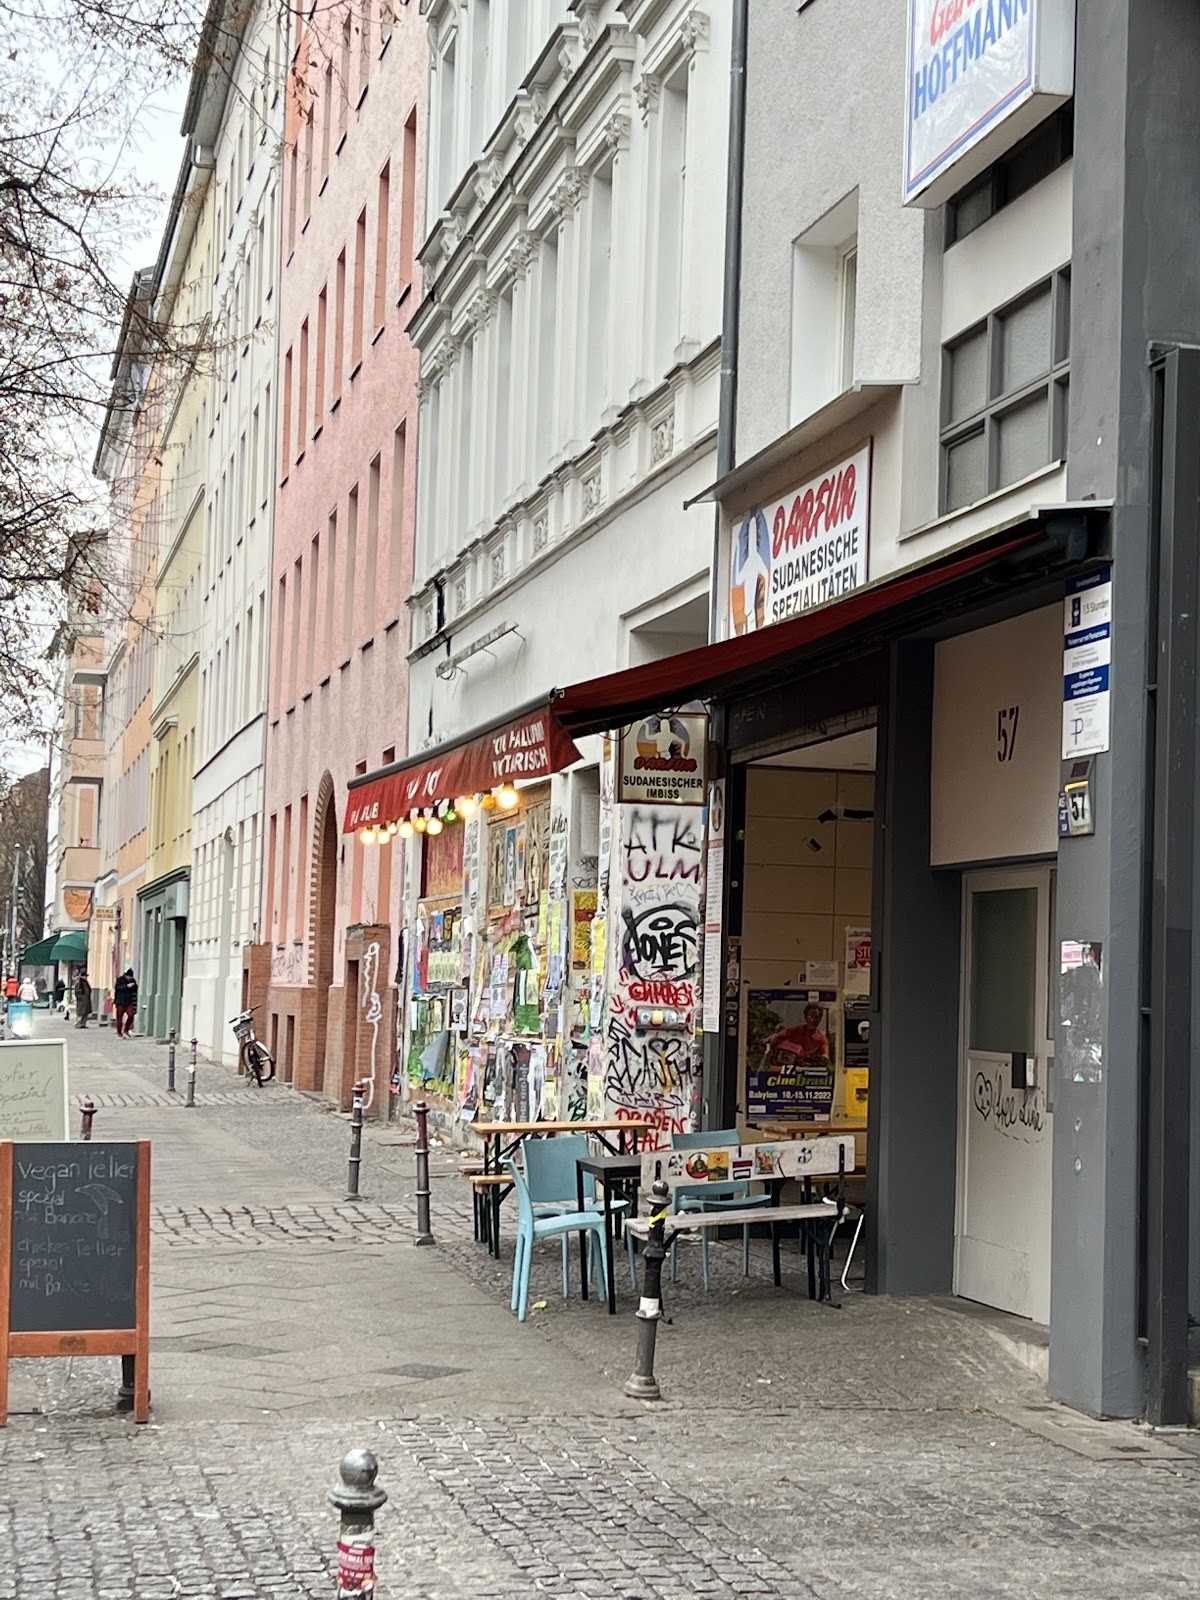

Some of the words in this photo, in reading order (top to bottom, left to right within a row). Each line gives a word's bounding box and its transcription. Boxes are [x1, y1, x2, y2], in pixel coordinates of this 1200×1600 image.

[772, 463, 857, 560] DARFUR
[772, 526, 859, 595] SUDANESISCHE
[772, 561, 858, 622] SPEZIALITÄTEN
[997, 705, 1019, 762] 57
[623, 775, 703, 789] SUDANESISCHER
[646, 788, 680, 799] IMBISS
[1069, 792, 1086, 821] 57
[0, 1062, 38, 1082] rfur
[18, 1161, 81, 1194] Vegan
